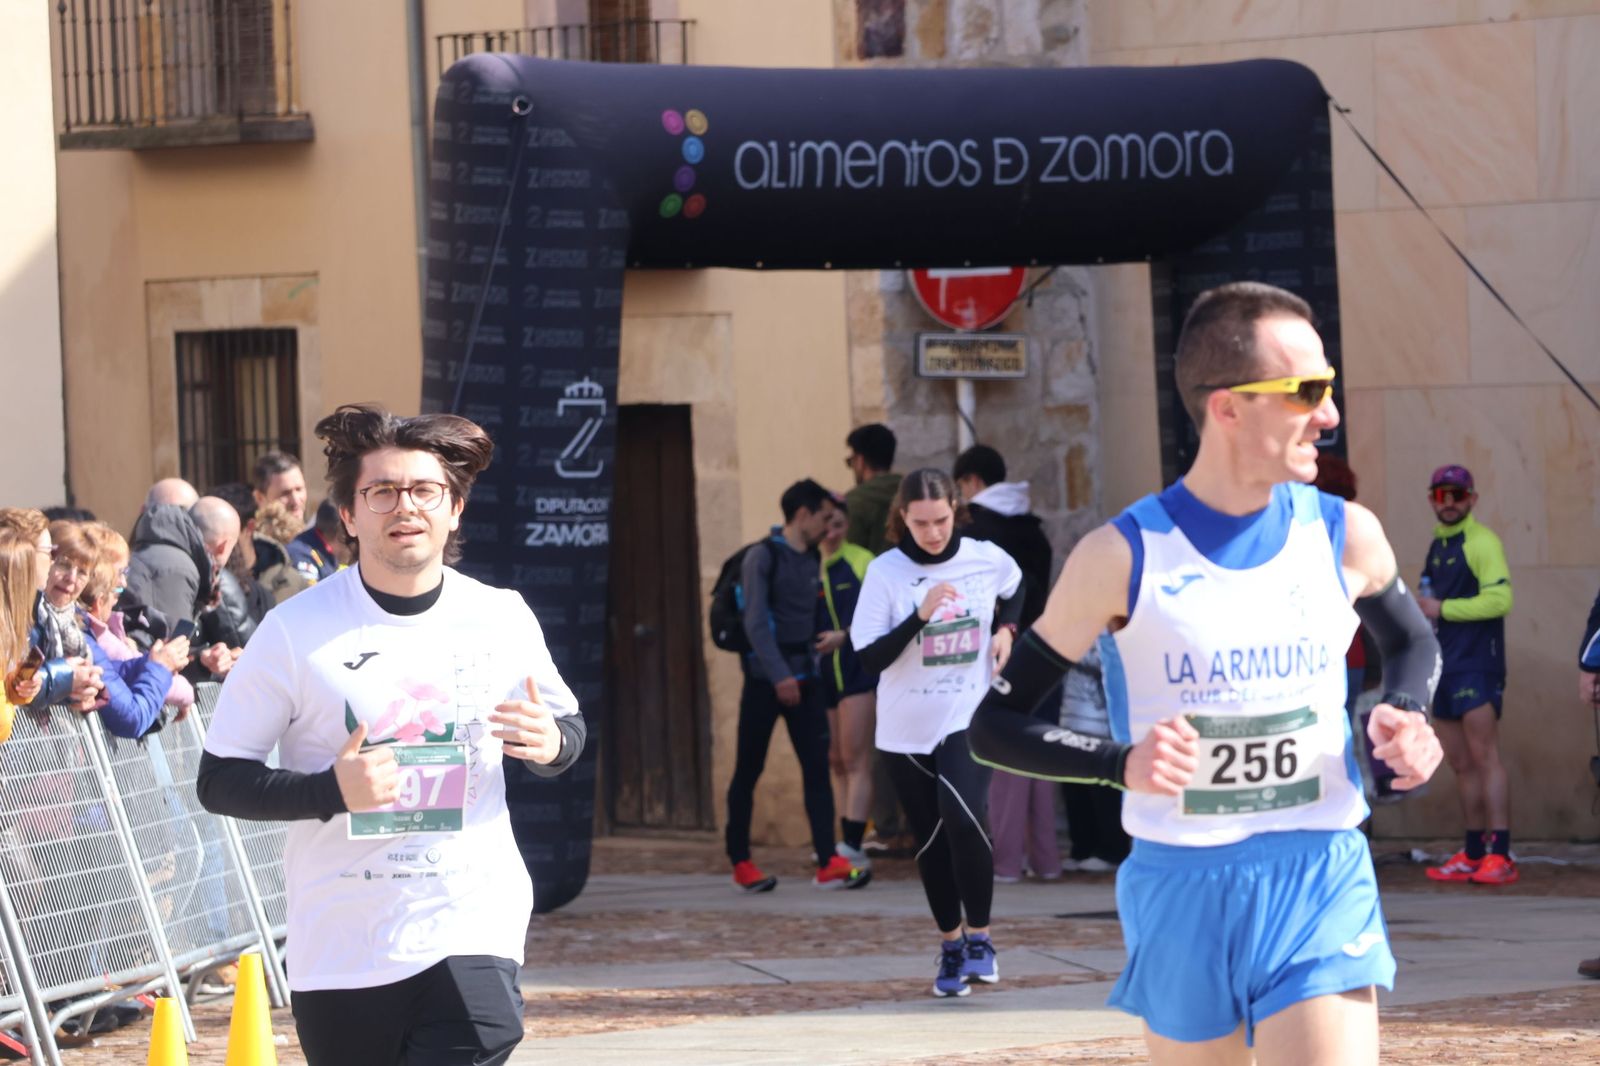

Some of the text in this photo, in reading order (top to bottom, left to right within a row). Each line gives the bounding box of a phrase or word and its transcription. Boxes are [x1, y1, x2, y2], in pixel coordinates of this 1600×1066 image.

[932, 631, 973, 655] 574
[1164, 636, 1331, 684] LA ARMUÑA
[1211, 738, 1298, 784] 256
[397, 768, 448, 808] 97
